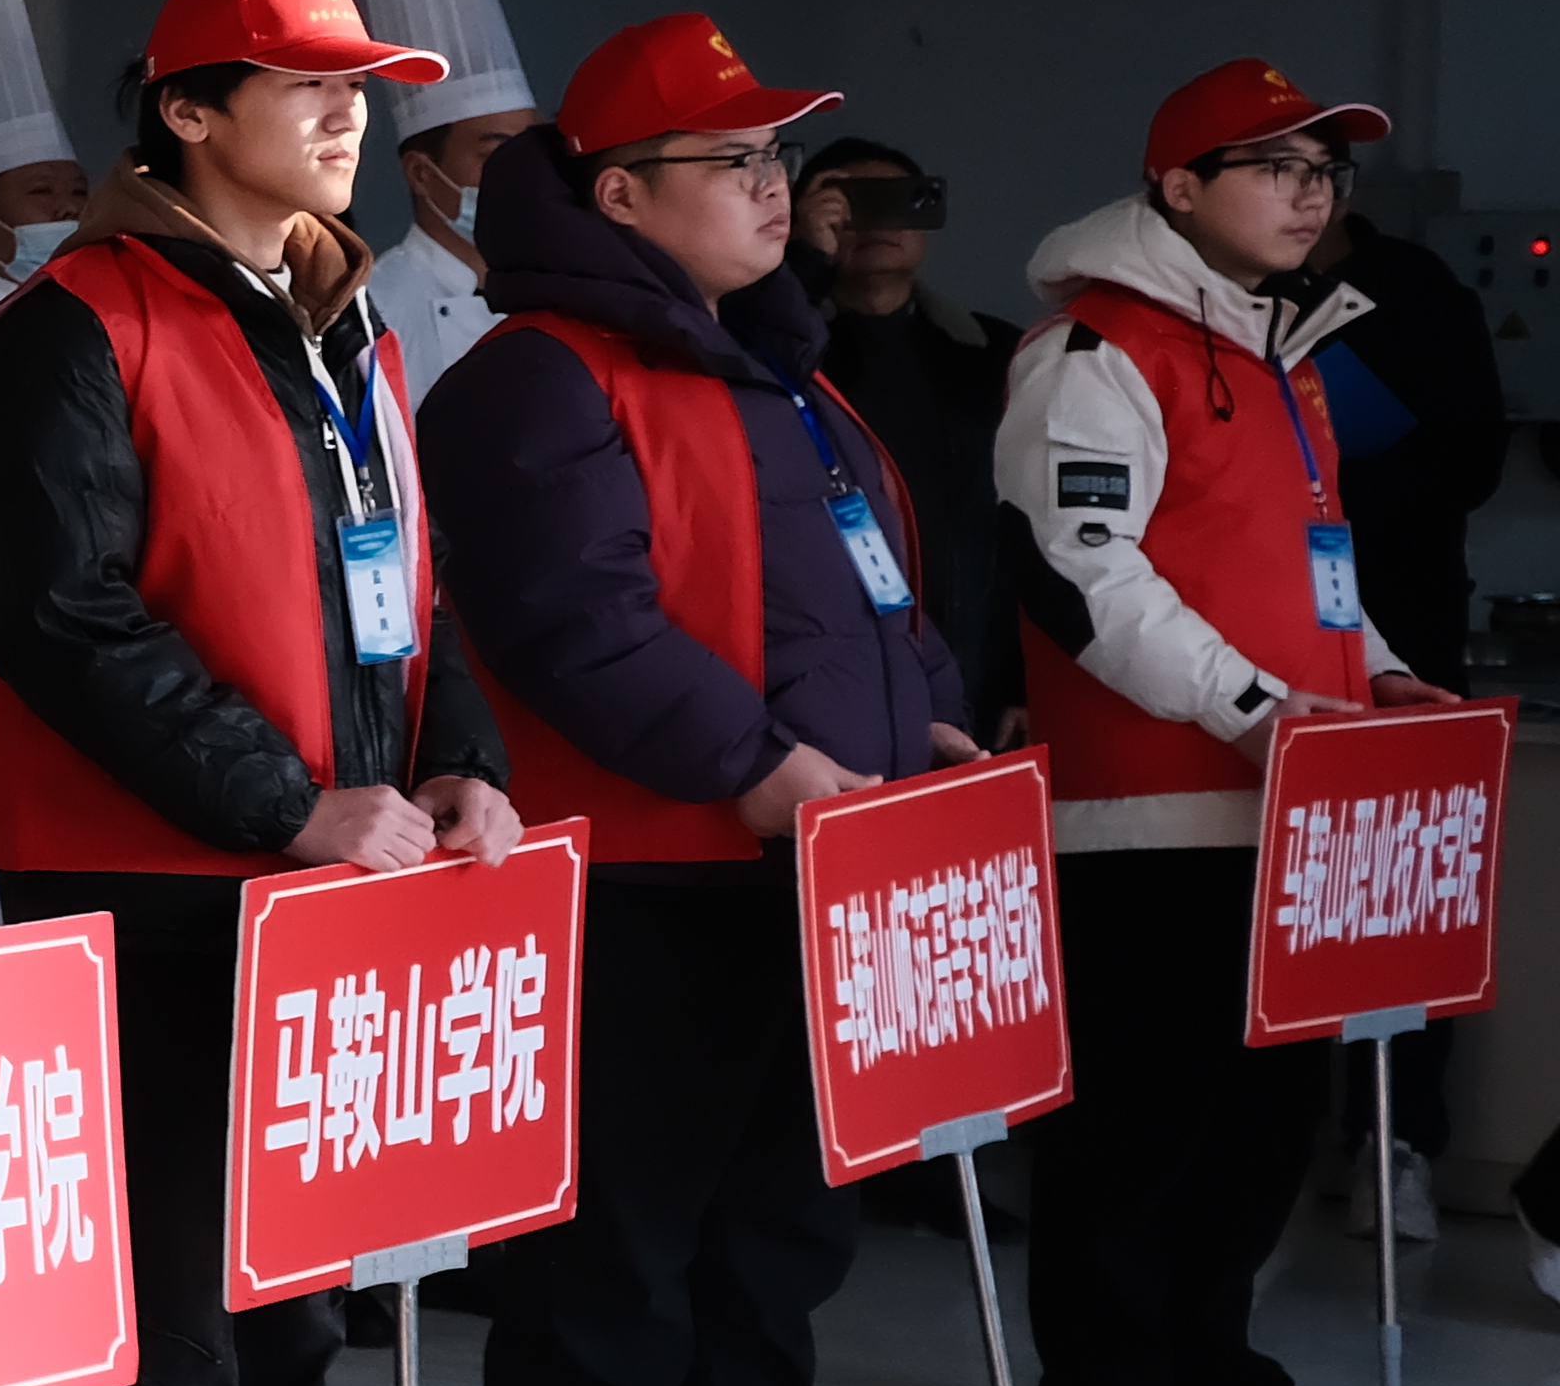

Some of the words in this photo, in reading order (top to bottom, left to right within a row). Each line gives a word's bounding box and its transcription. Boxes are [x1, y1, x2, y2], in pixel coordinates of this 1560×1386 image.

[829, 846, 1050, 1075] 马鞍山师范高等专科学校
[1277, 780, 1488, 955] 马鞍山职业技术学院
[263, 933, 548, 1184] 马鞍山学院
